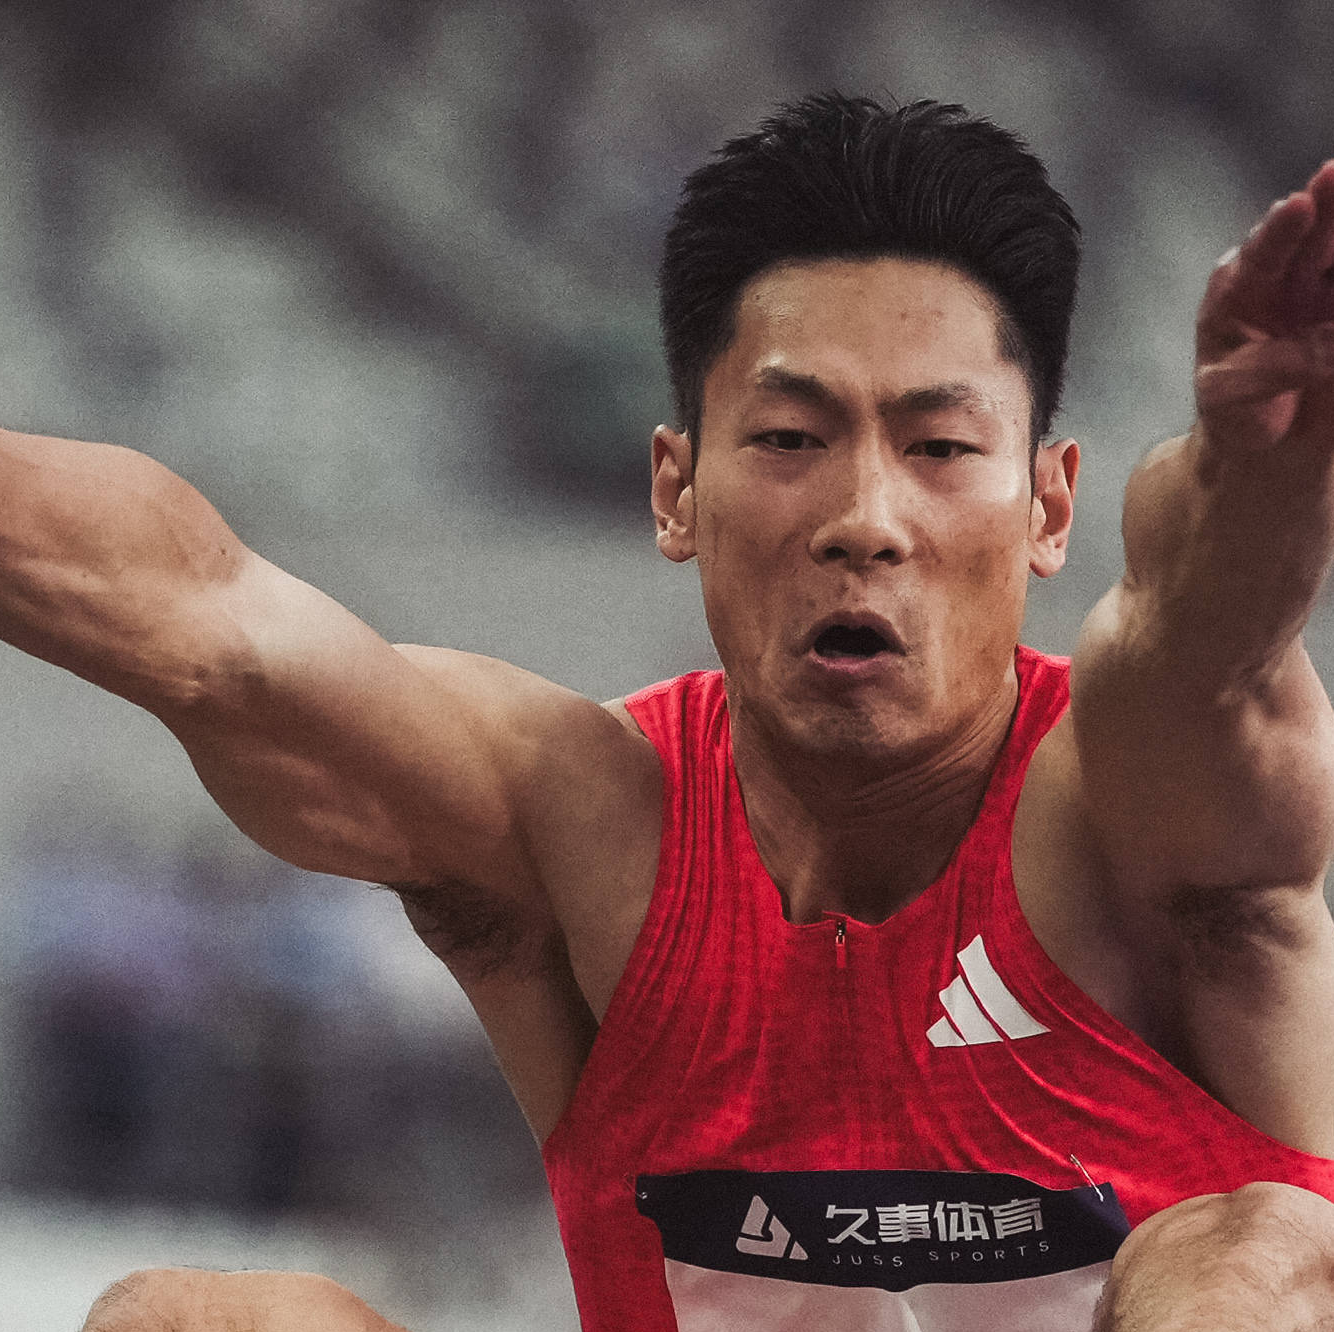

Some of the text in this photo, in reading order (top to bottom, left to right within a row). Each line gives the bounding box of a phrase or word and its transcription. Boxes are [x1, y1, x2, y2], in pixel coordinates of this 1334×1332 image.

[825, 1198, 1044, 1245] 久事体育
[832, 1241, 1050, 1267] JUSS SPORTS
